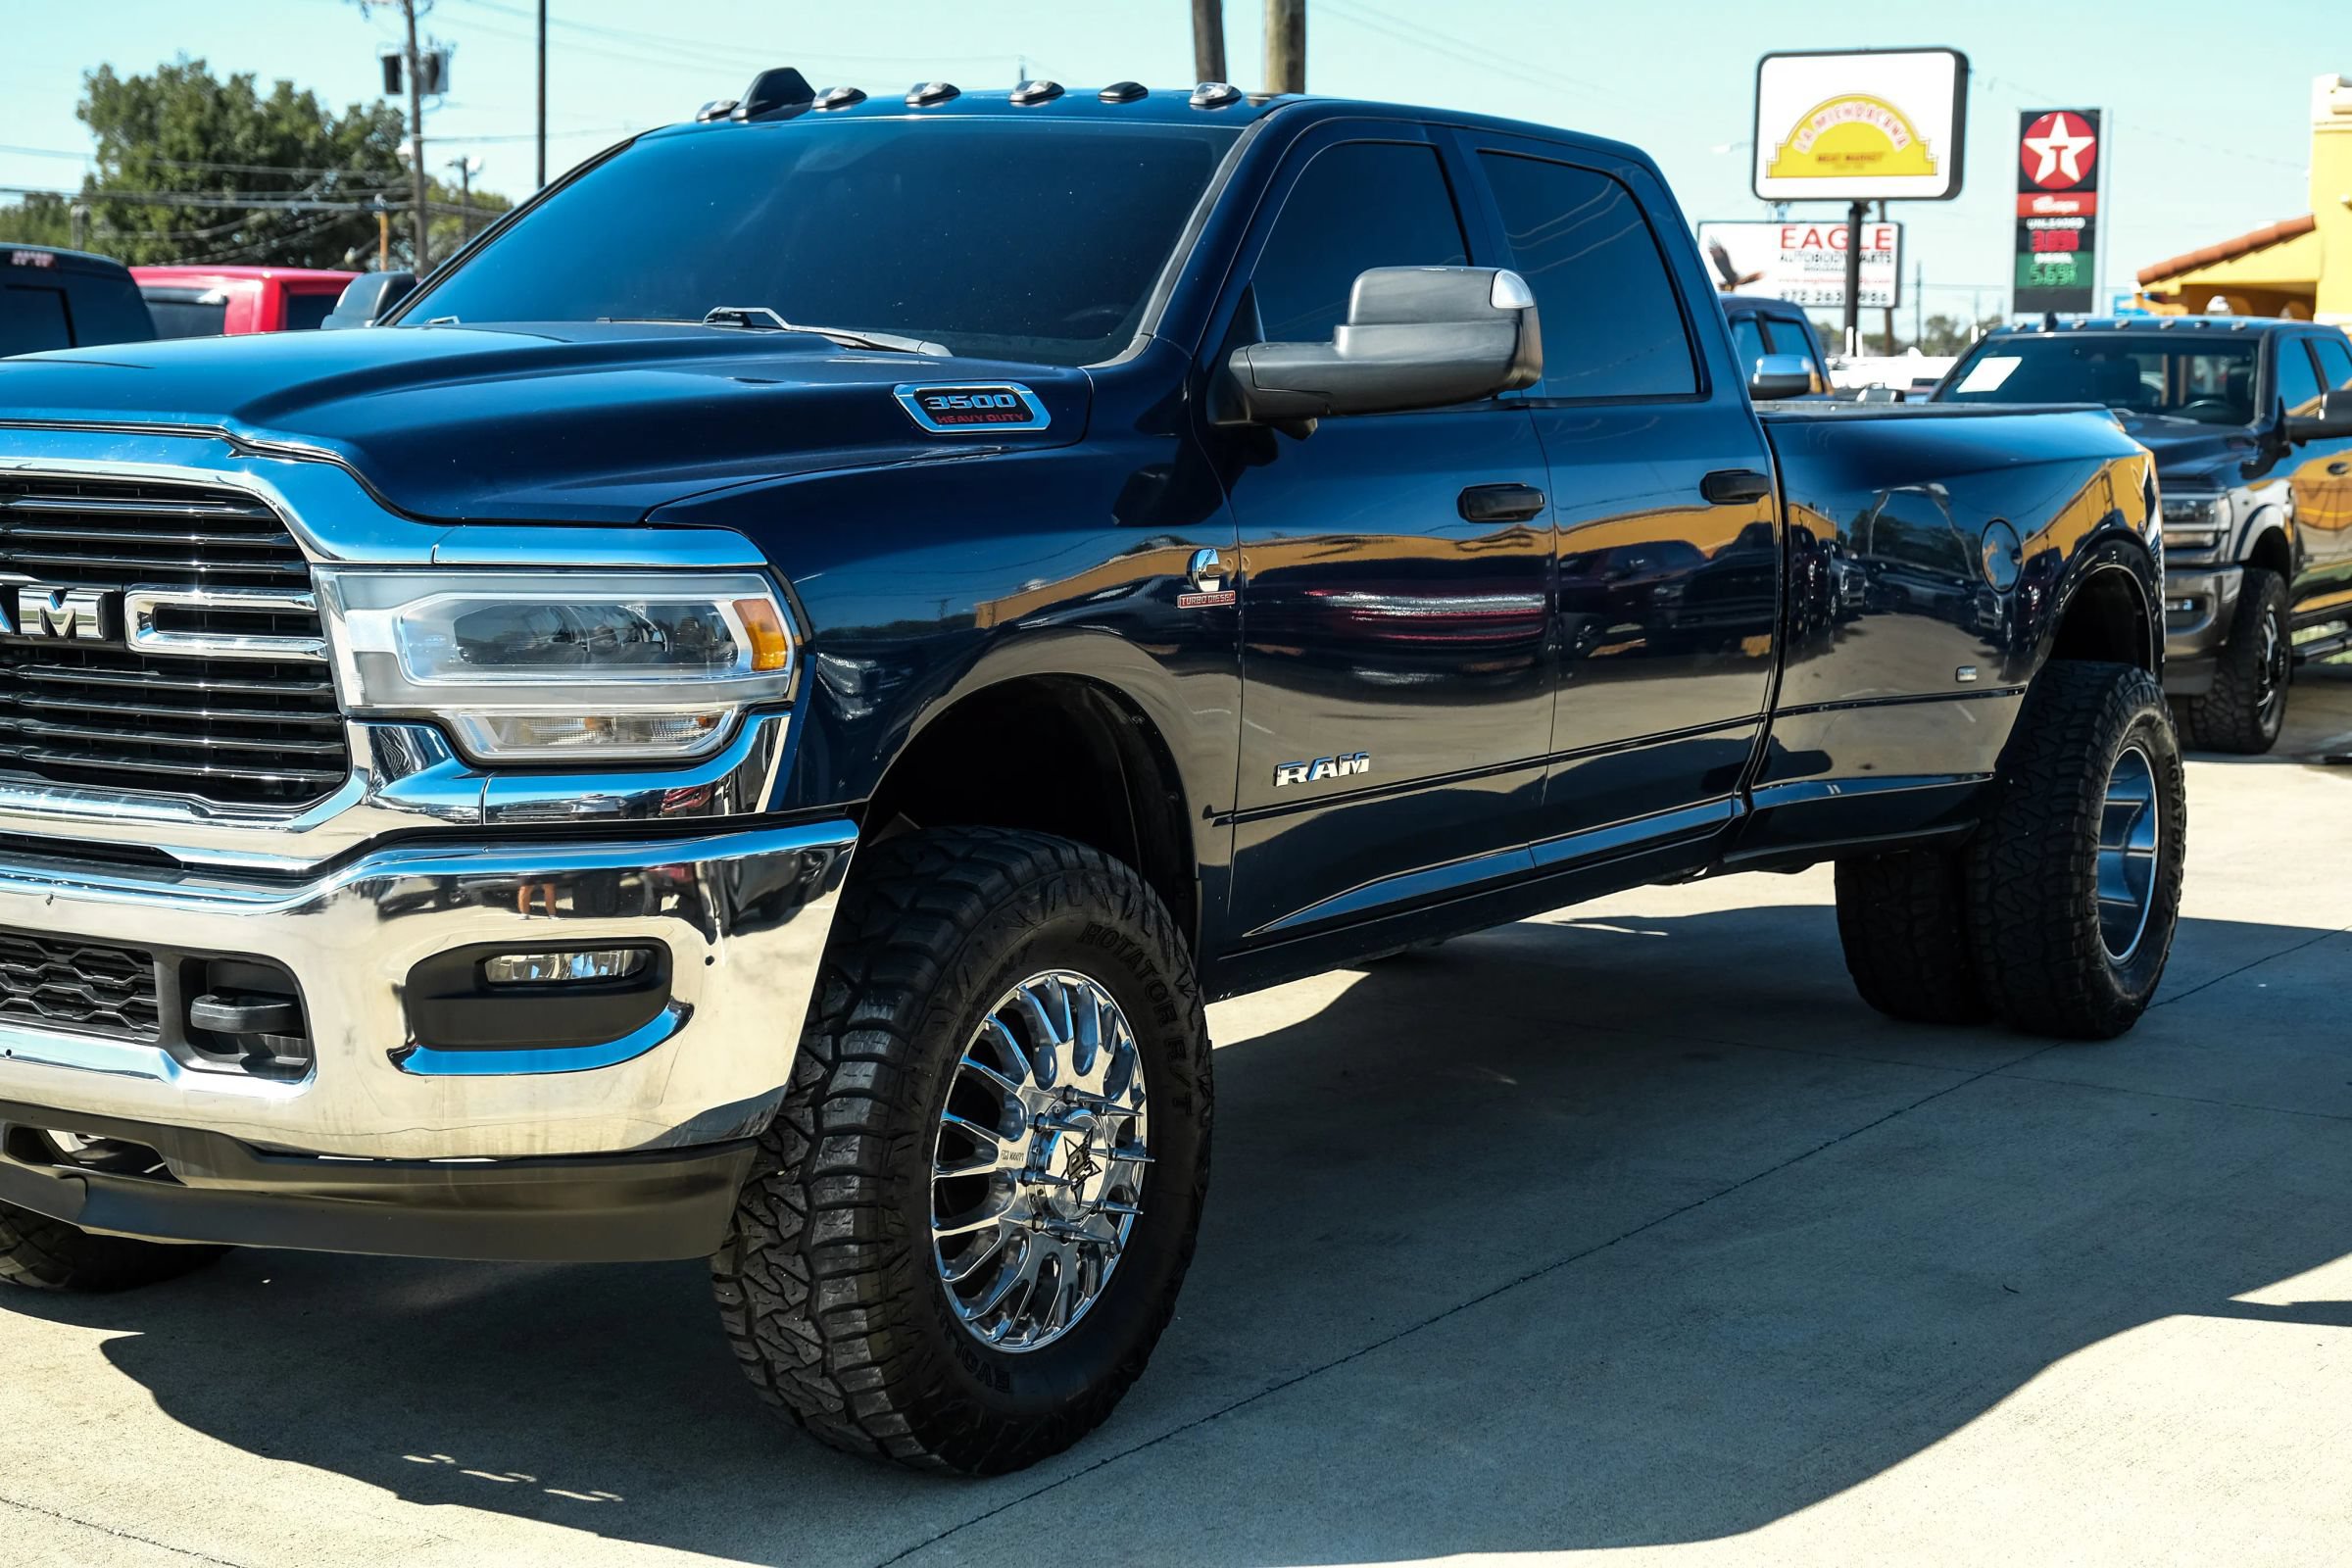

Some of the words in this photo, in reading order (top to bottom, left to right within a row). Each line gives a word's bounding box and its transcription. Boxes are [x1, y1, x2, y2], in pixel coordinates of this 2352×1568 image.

[1859, 252, 1892, 264] ARTS
[925, 394, 1017, 410] 3500
[936, 415, 983, 424] HEAVY
[985, 414, 1024, 422] DUTY
[1181, 595, 1207, 606] TURBO
[1207, 592, 1235, 604] DIESEL
[1273, 751, 1370, 788] RAM
[1076, 921, 1178, 1028] ROTATOR
[1165, 1036, 1194, 1115] R/T
